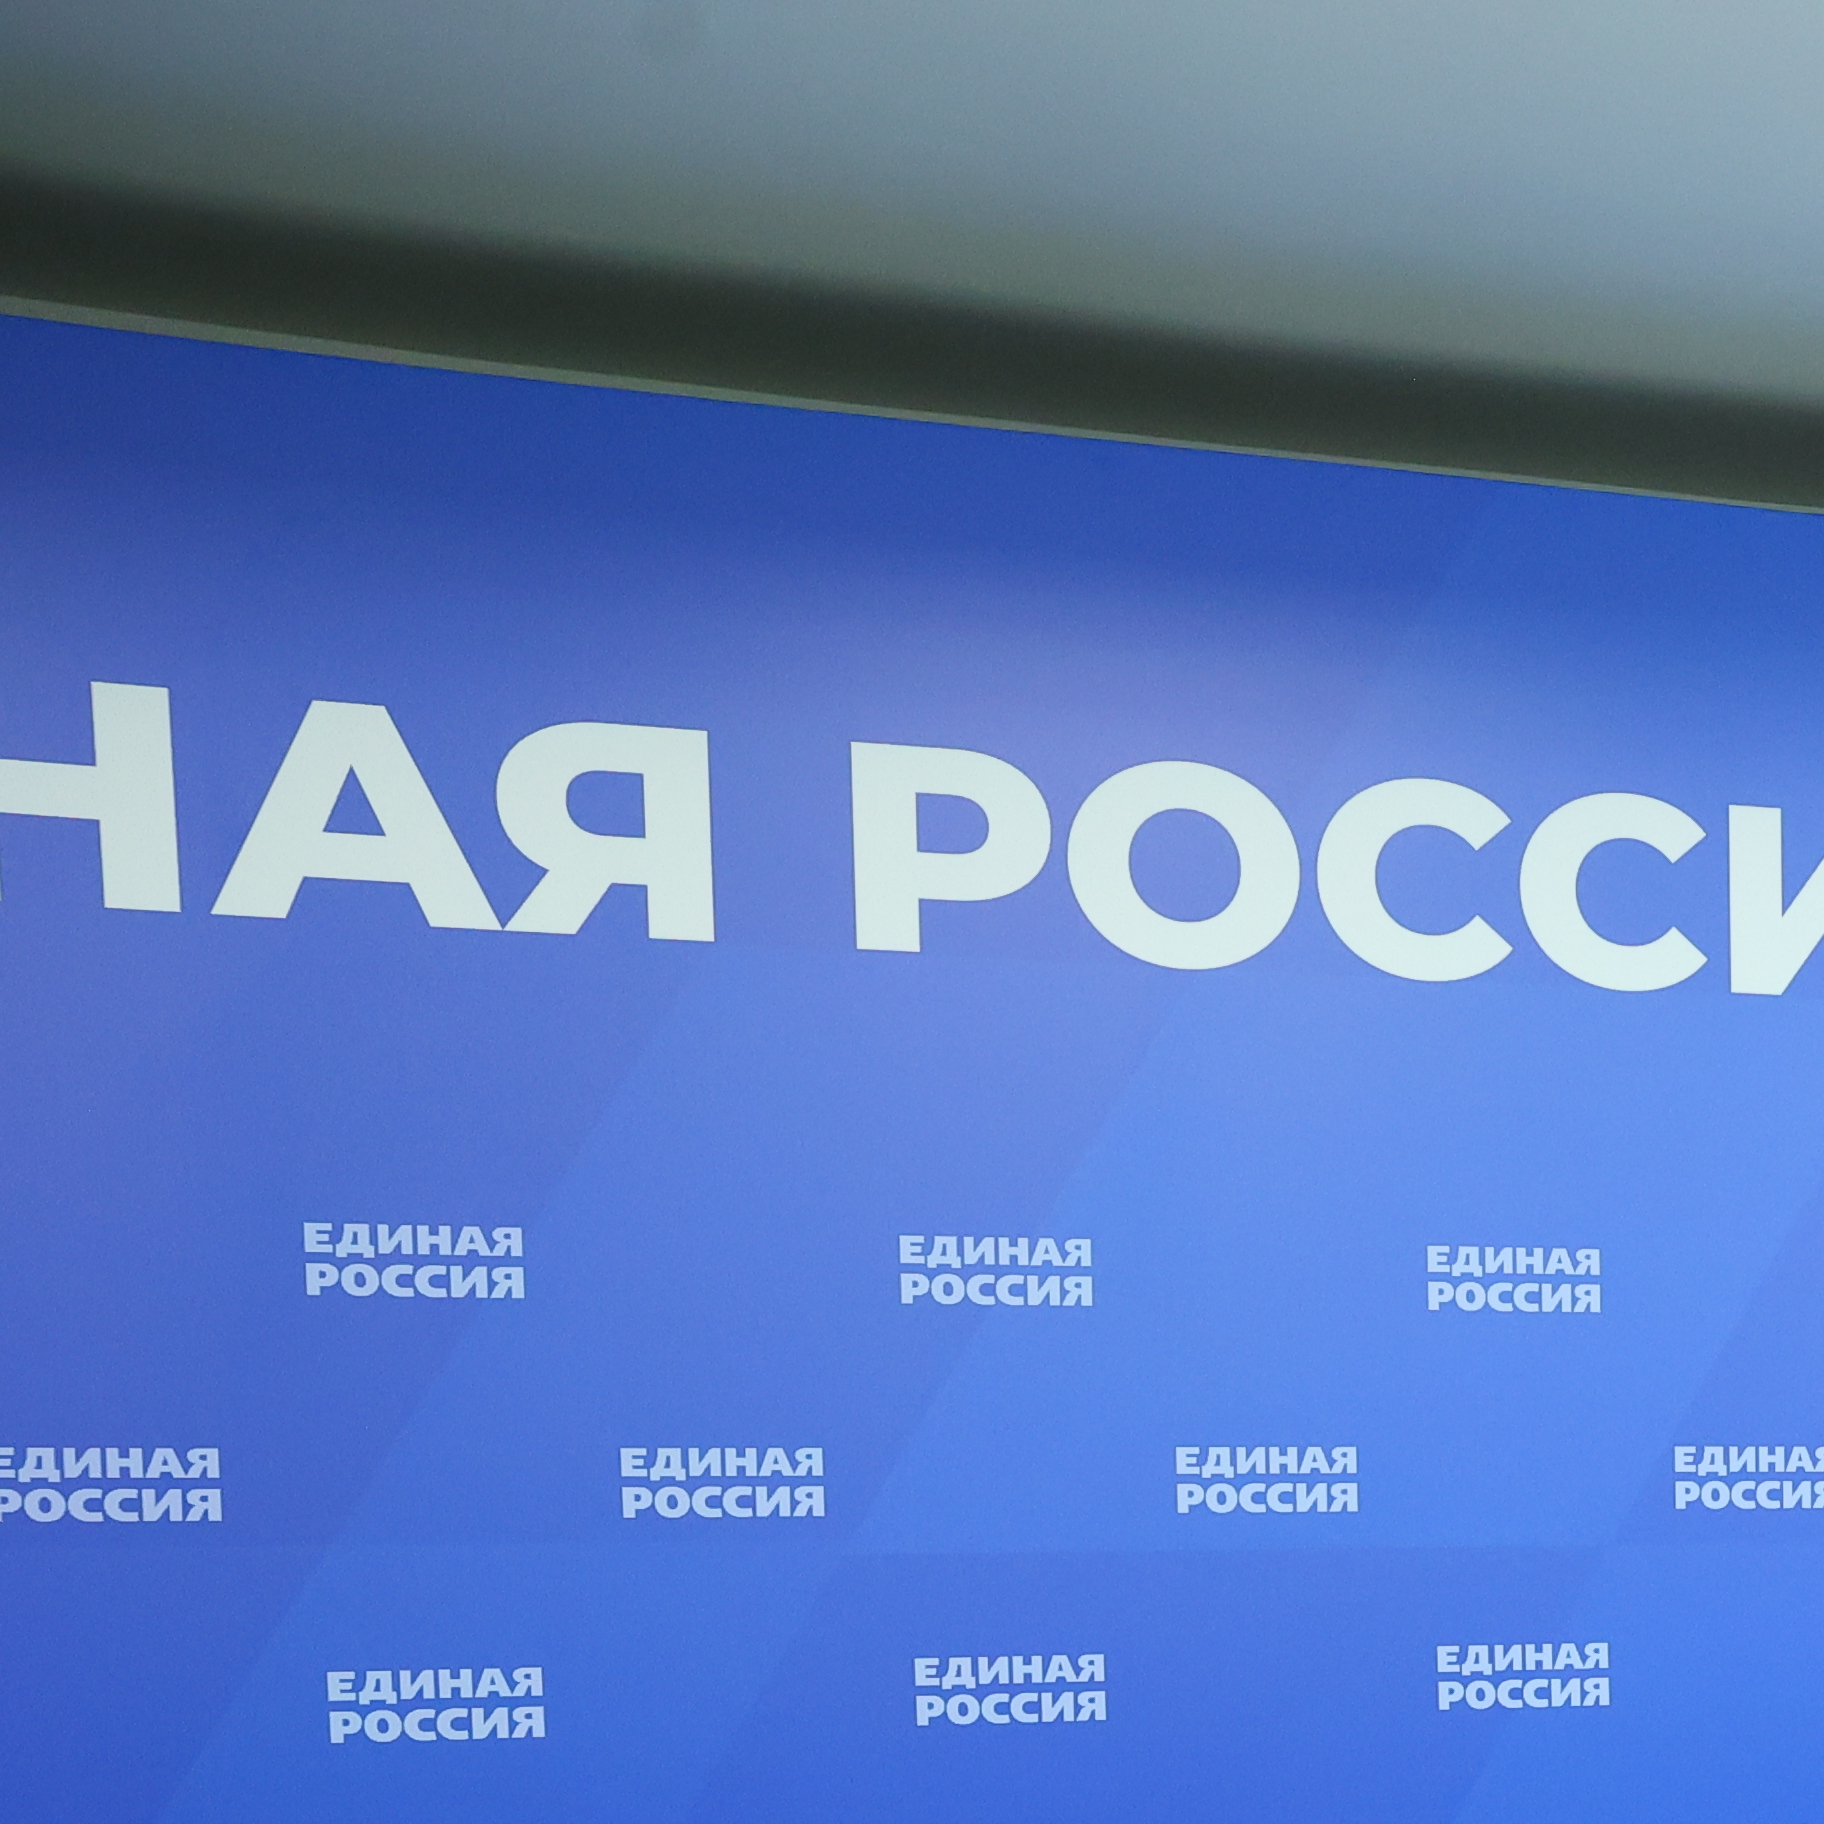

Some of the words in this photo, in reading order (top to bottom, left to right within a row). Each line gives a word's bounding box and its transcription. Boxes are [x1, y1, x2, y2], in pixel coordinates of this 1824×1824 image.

[304, 1222, 523, 1258] ЕДИНАЯ
[899, 1235, 1091, 1268] ЕДИНАЯ
[1427, 1246, 1600, 1277] ЕДИНАЯ
[305, 1263, 525, 1298] РОССИЯ
[900, 1273, 1092, 1306] РОССИЯ
[1428, 1281, 1601, 1313] РОССИЯ
[0, 1447, 220, 1483] ЕДИНАЯ
[620, 1448, 823, 1481] ЕДИНАЯ
[1176, 1447, 1357, 1478] ЕДИНАЯ
[622, 1486, 825, 1518] РОССИЯ
[1177, 1483, 1358, 1513] РОССИЯ
[914, 1654, 1105, 1690] ЕДИНАЯ
[1437, 1643, 1609, 1676] ЕДИНАЯ
[327, 1667, 543, 1705] ЕДИНАЯ
[1438, 1677, 1610, 1710] РОССИЯ
[329, 1706, 545, 1743] РОССИЯ
[916, 1691, 1106, 1726] РОССИЯ
